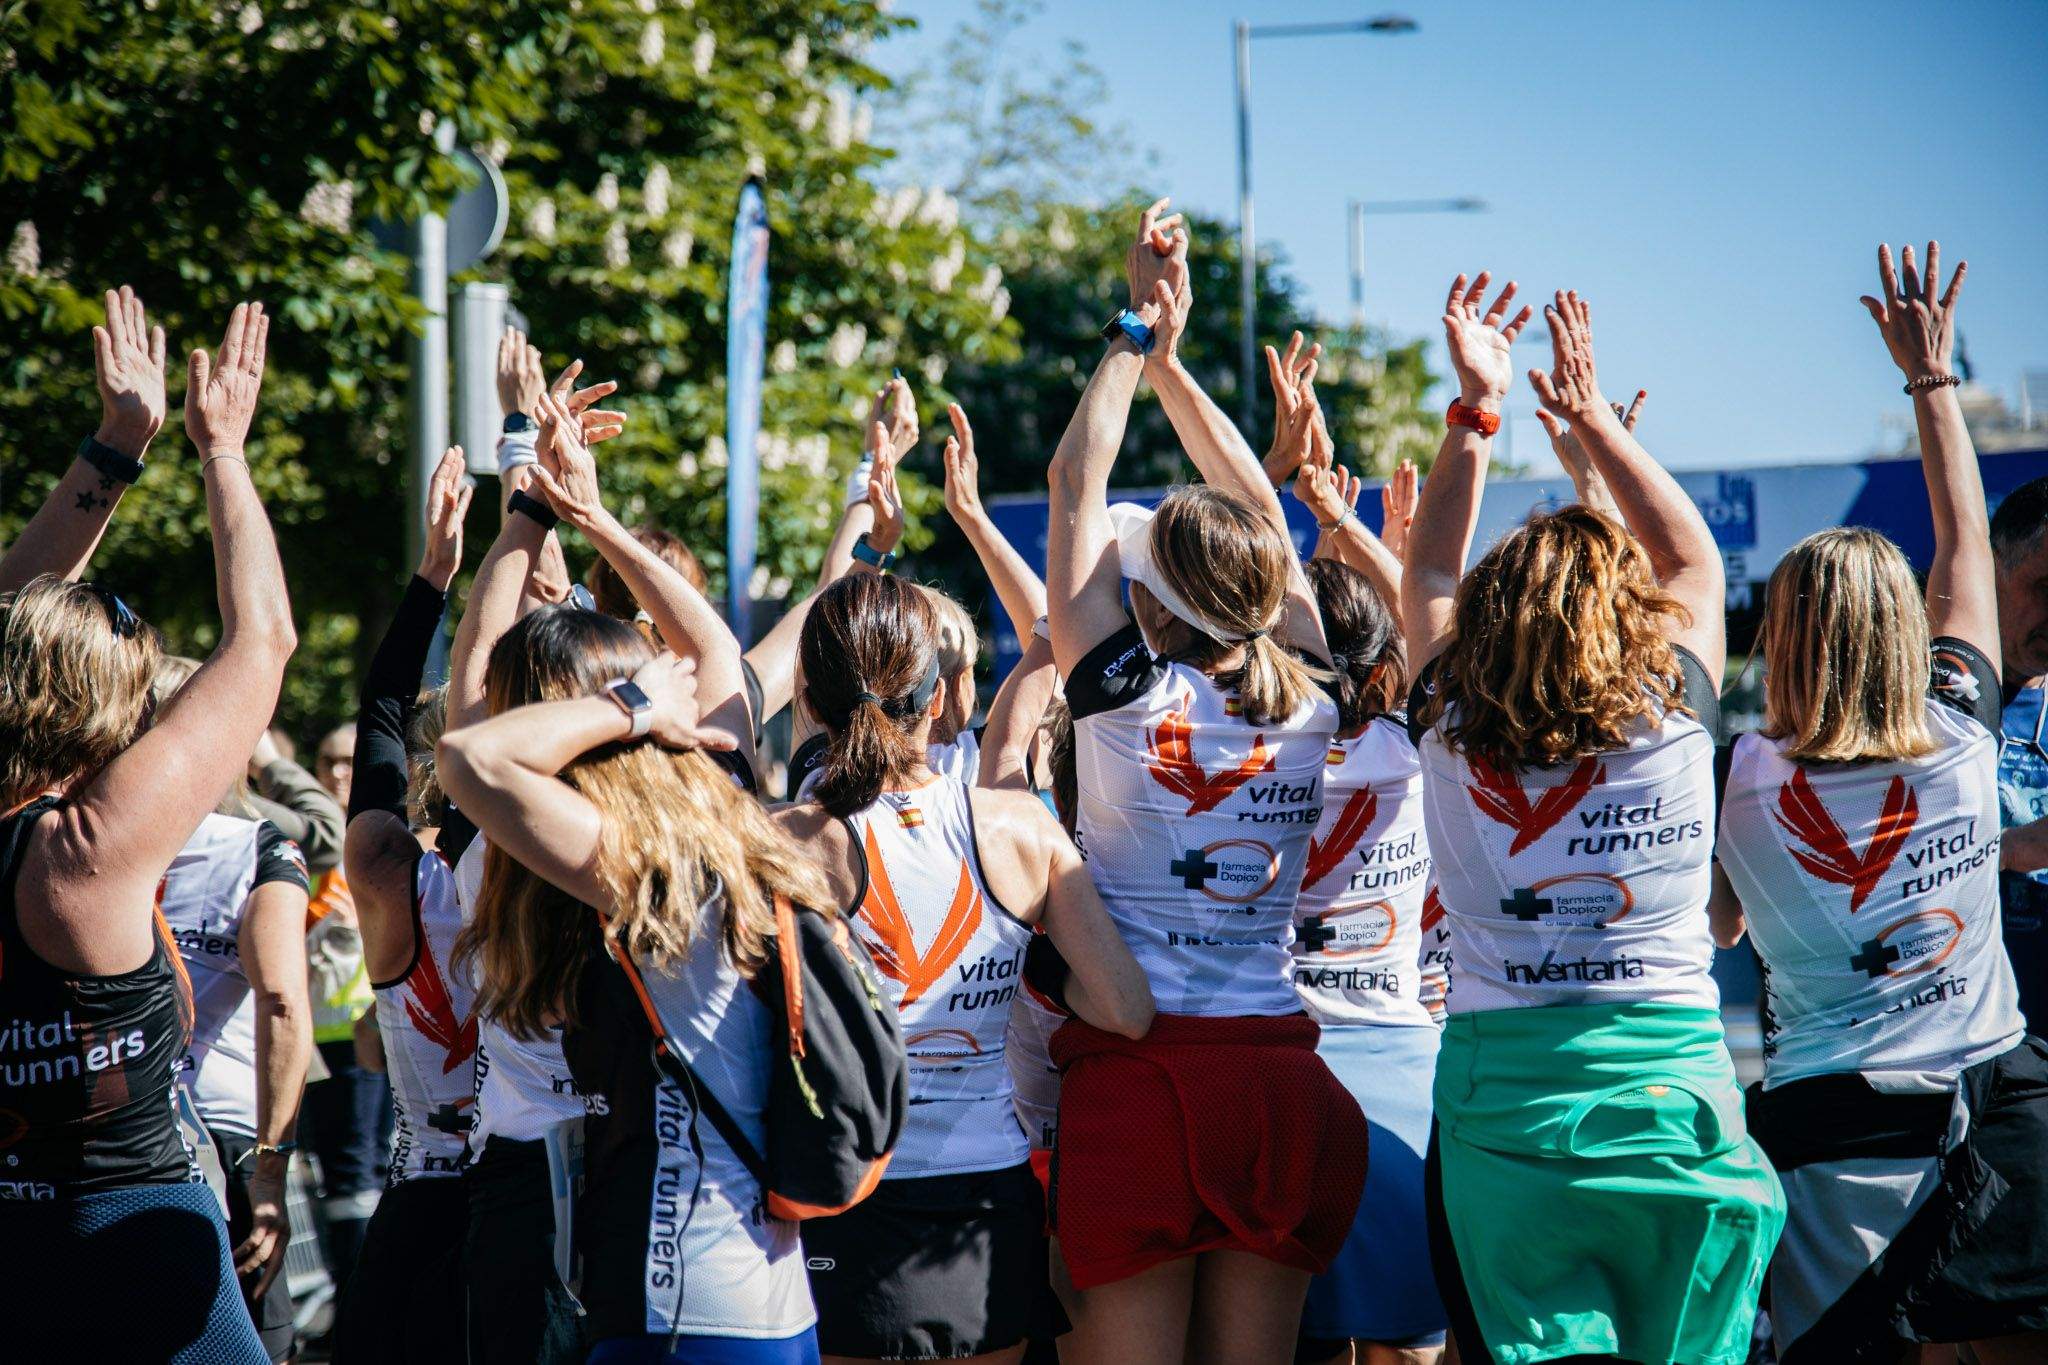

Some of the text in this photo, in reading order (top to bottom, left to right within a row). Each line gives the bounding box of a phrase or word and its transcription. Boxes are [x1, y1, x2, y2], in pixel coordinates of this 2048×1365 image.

[1250, 777, 1316, 803] vital
[1580, 797, 1663, 829] vital
[1359, 832, 1416, 865] vital
[1567, 820, 1703, 857] runners
[1906, 820, 1976, 869] vital
[1221, 861, 1266, 873] farmacia
[1221, 871, 1259, 884] Dopico
[1556, 895, 1614, 905] farmacia
[1558, 904, 1606, 916] Dopico
[1339, 920, 1385, 932] farmacia
[1340, 931, 1377, 942] Dopico
[1903, 941, 1945, 960] Dopico
[959, 949, 1020, 983] vital
[1295, 966, 1399, 992] nventaria
[1504, 950, 1644, 984] inventaria
[0, 1029, 146, 1086] unners
[652, 1082, 691, 1289] vital runners
